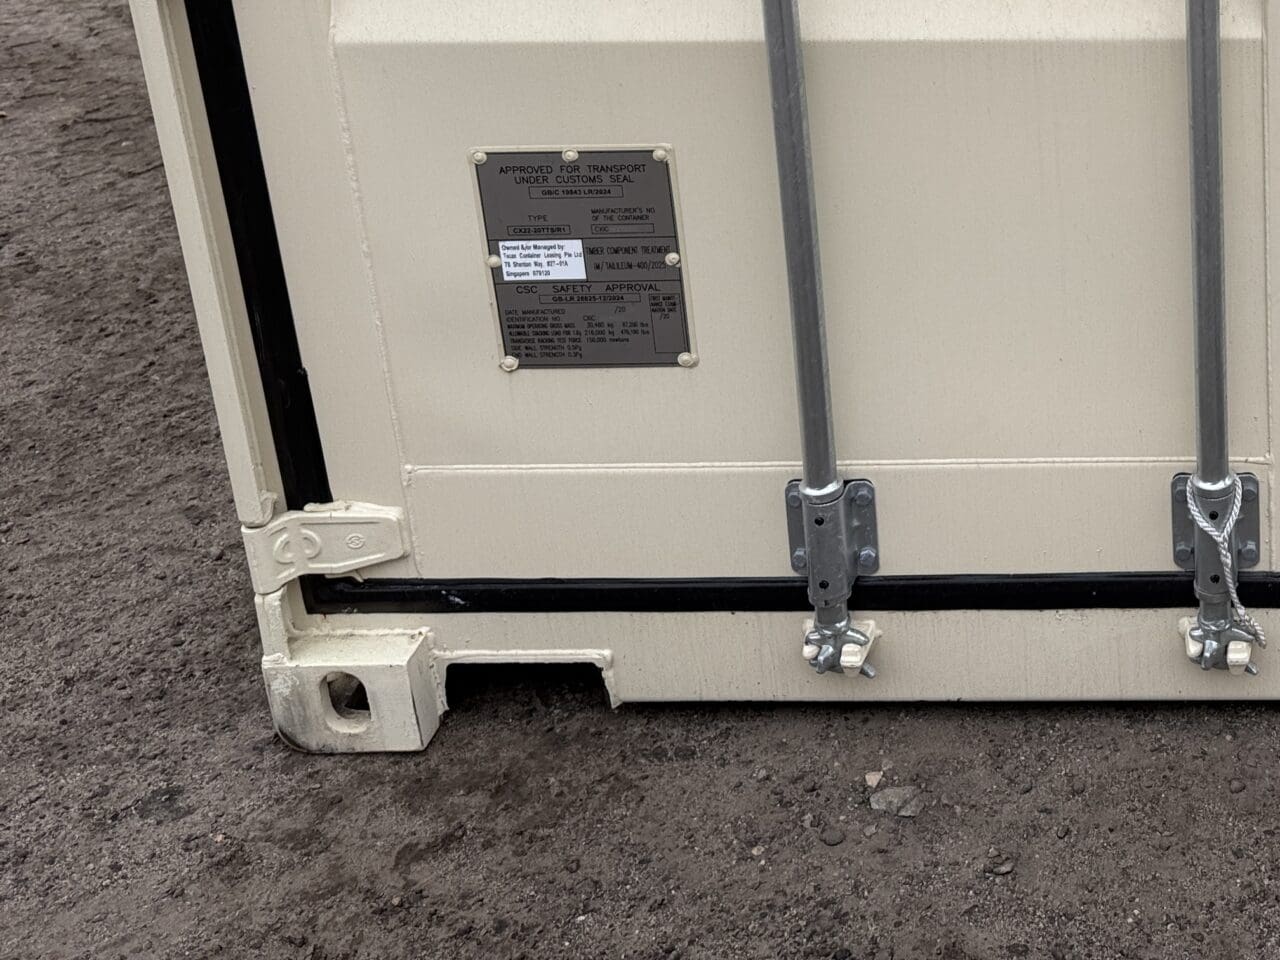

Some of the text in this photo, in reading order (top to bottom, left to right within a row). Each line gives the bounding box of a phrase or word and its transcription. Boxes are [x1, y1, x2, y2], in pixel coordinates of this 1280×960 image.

[499, 164, 646, 175] APPROVED FOR TRANSPORT
[514, 174, 634, 184] UNDER CUSTOMS SEAL
[528, 214, 548, 222] TYPE
[516, 283, 662, 294] CSC SAFETY APPROVAL
